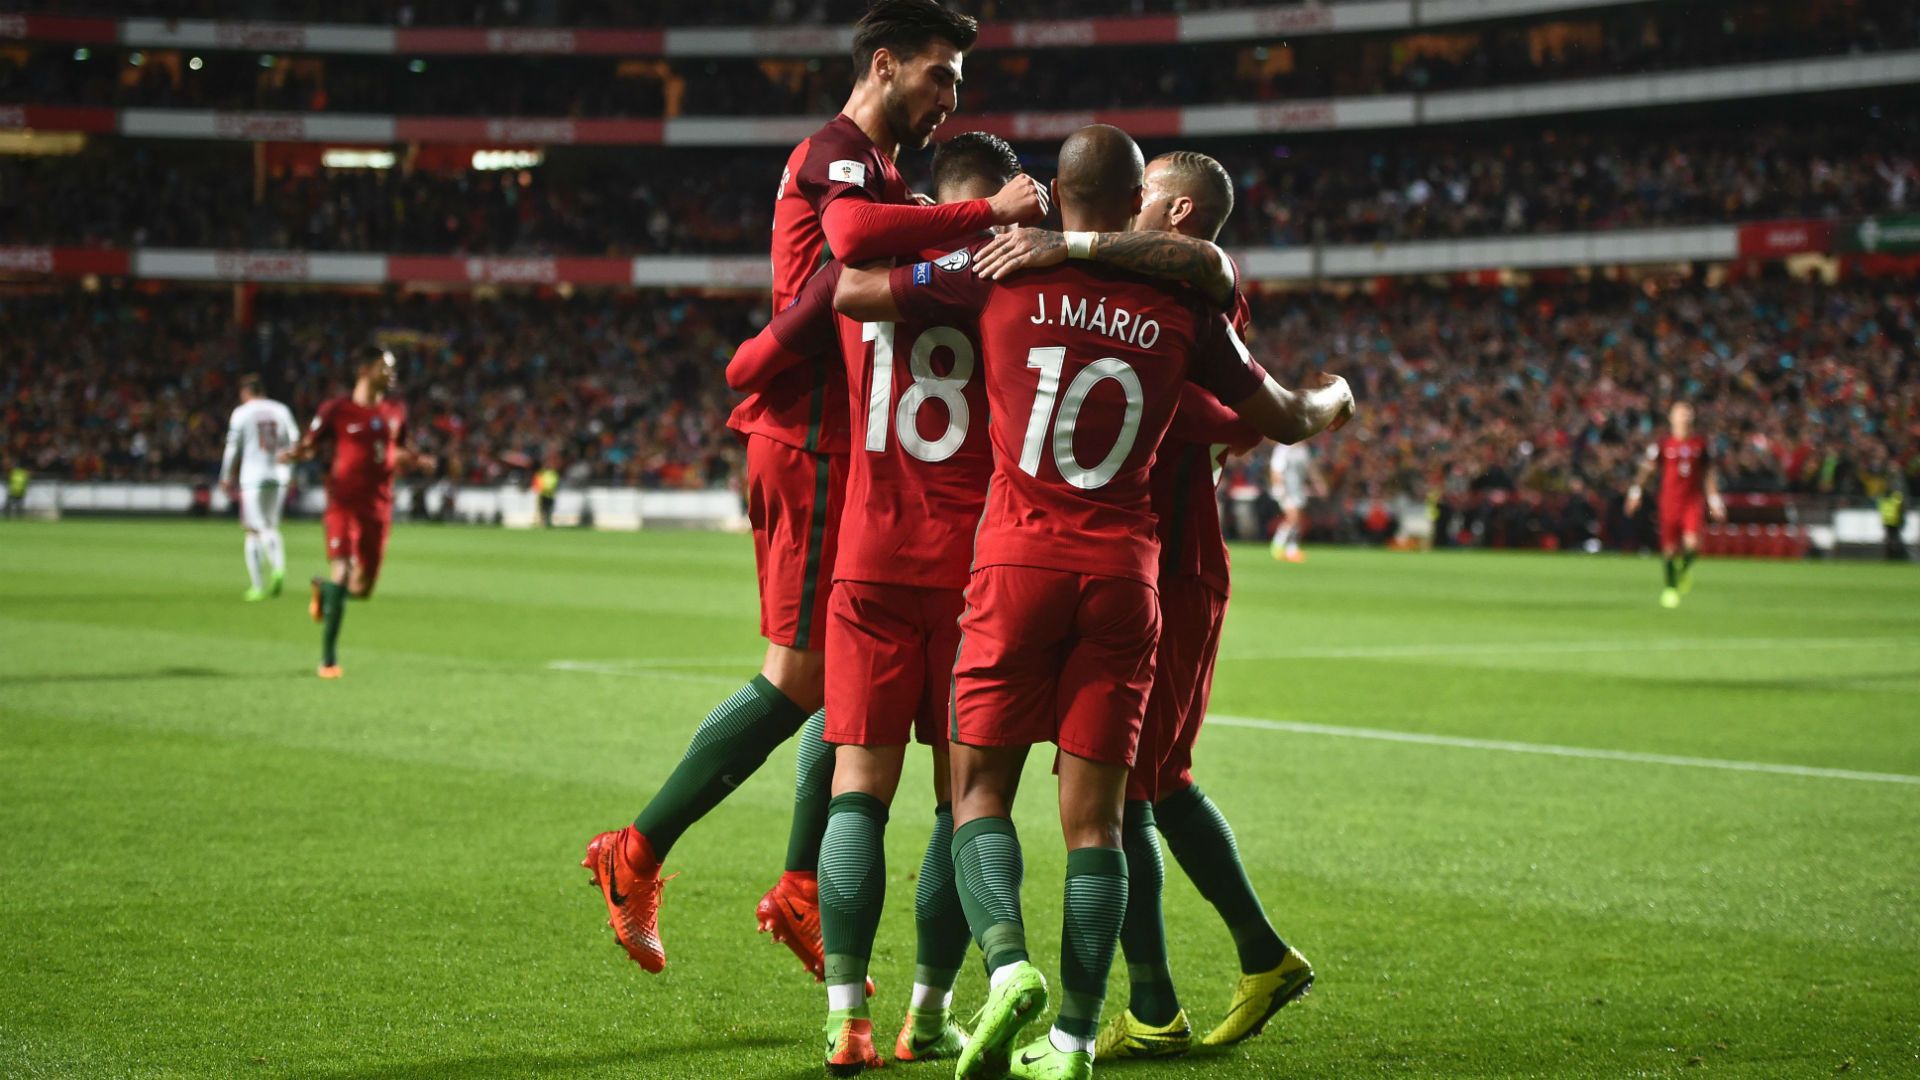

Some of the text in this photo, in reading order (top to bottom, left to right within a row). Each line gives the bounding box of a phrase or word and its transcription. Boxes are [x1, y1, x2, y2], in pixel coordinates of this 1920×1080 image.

[1030, 292, 1160, 349] J. MÁRIO
[862, 321, 975, 462] 18
[1018, 346, 1144, 490] 10
